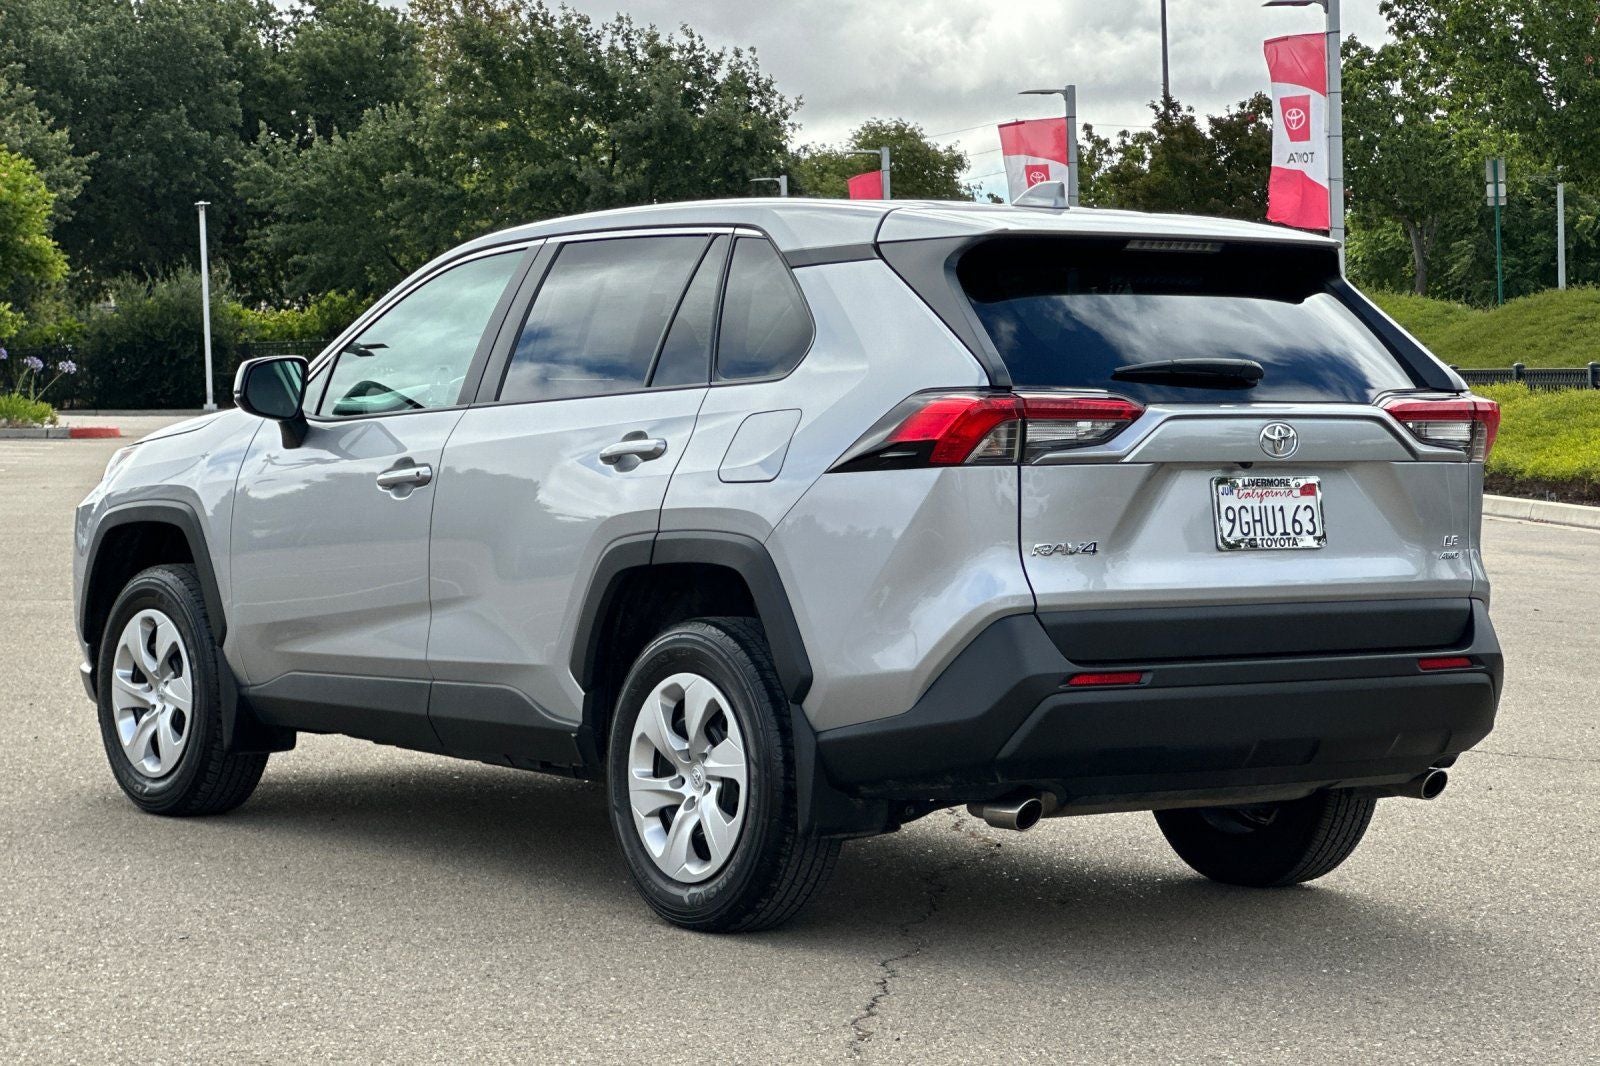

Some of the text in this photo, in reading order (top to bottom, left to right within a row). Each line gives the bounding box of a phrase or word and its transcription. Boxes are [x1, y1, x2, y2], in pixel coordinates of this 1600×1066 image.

[1242, 478, 1290, 487] LIVERMORE
[1221, 487, 1234, 496] JUN
[1236, 488, 1300, 503] California
[1225, 505, 1316, 537] 9GHU163
[1259, 537, 1298, 547] TOYOTA
[1443, 535, 1458, 546] LE
[1031, 541, 1099, 556] RAV4
